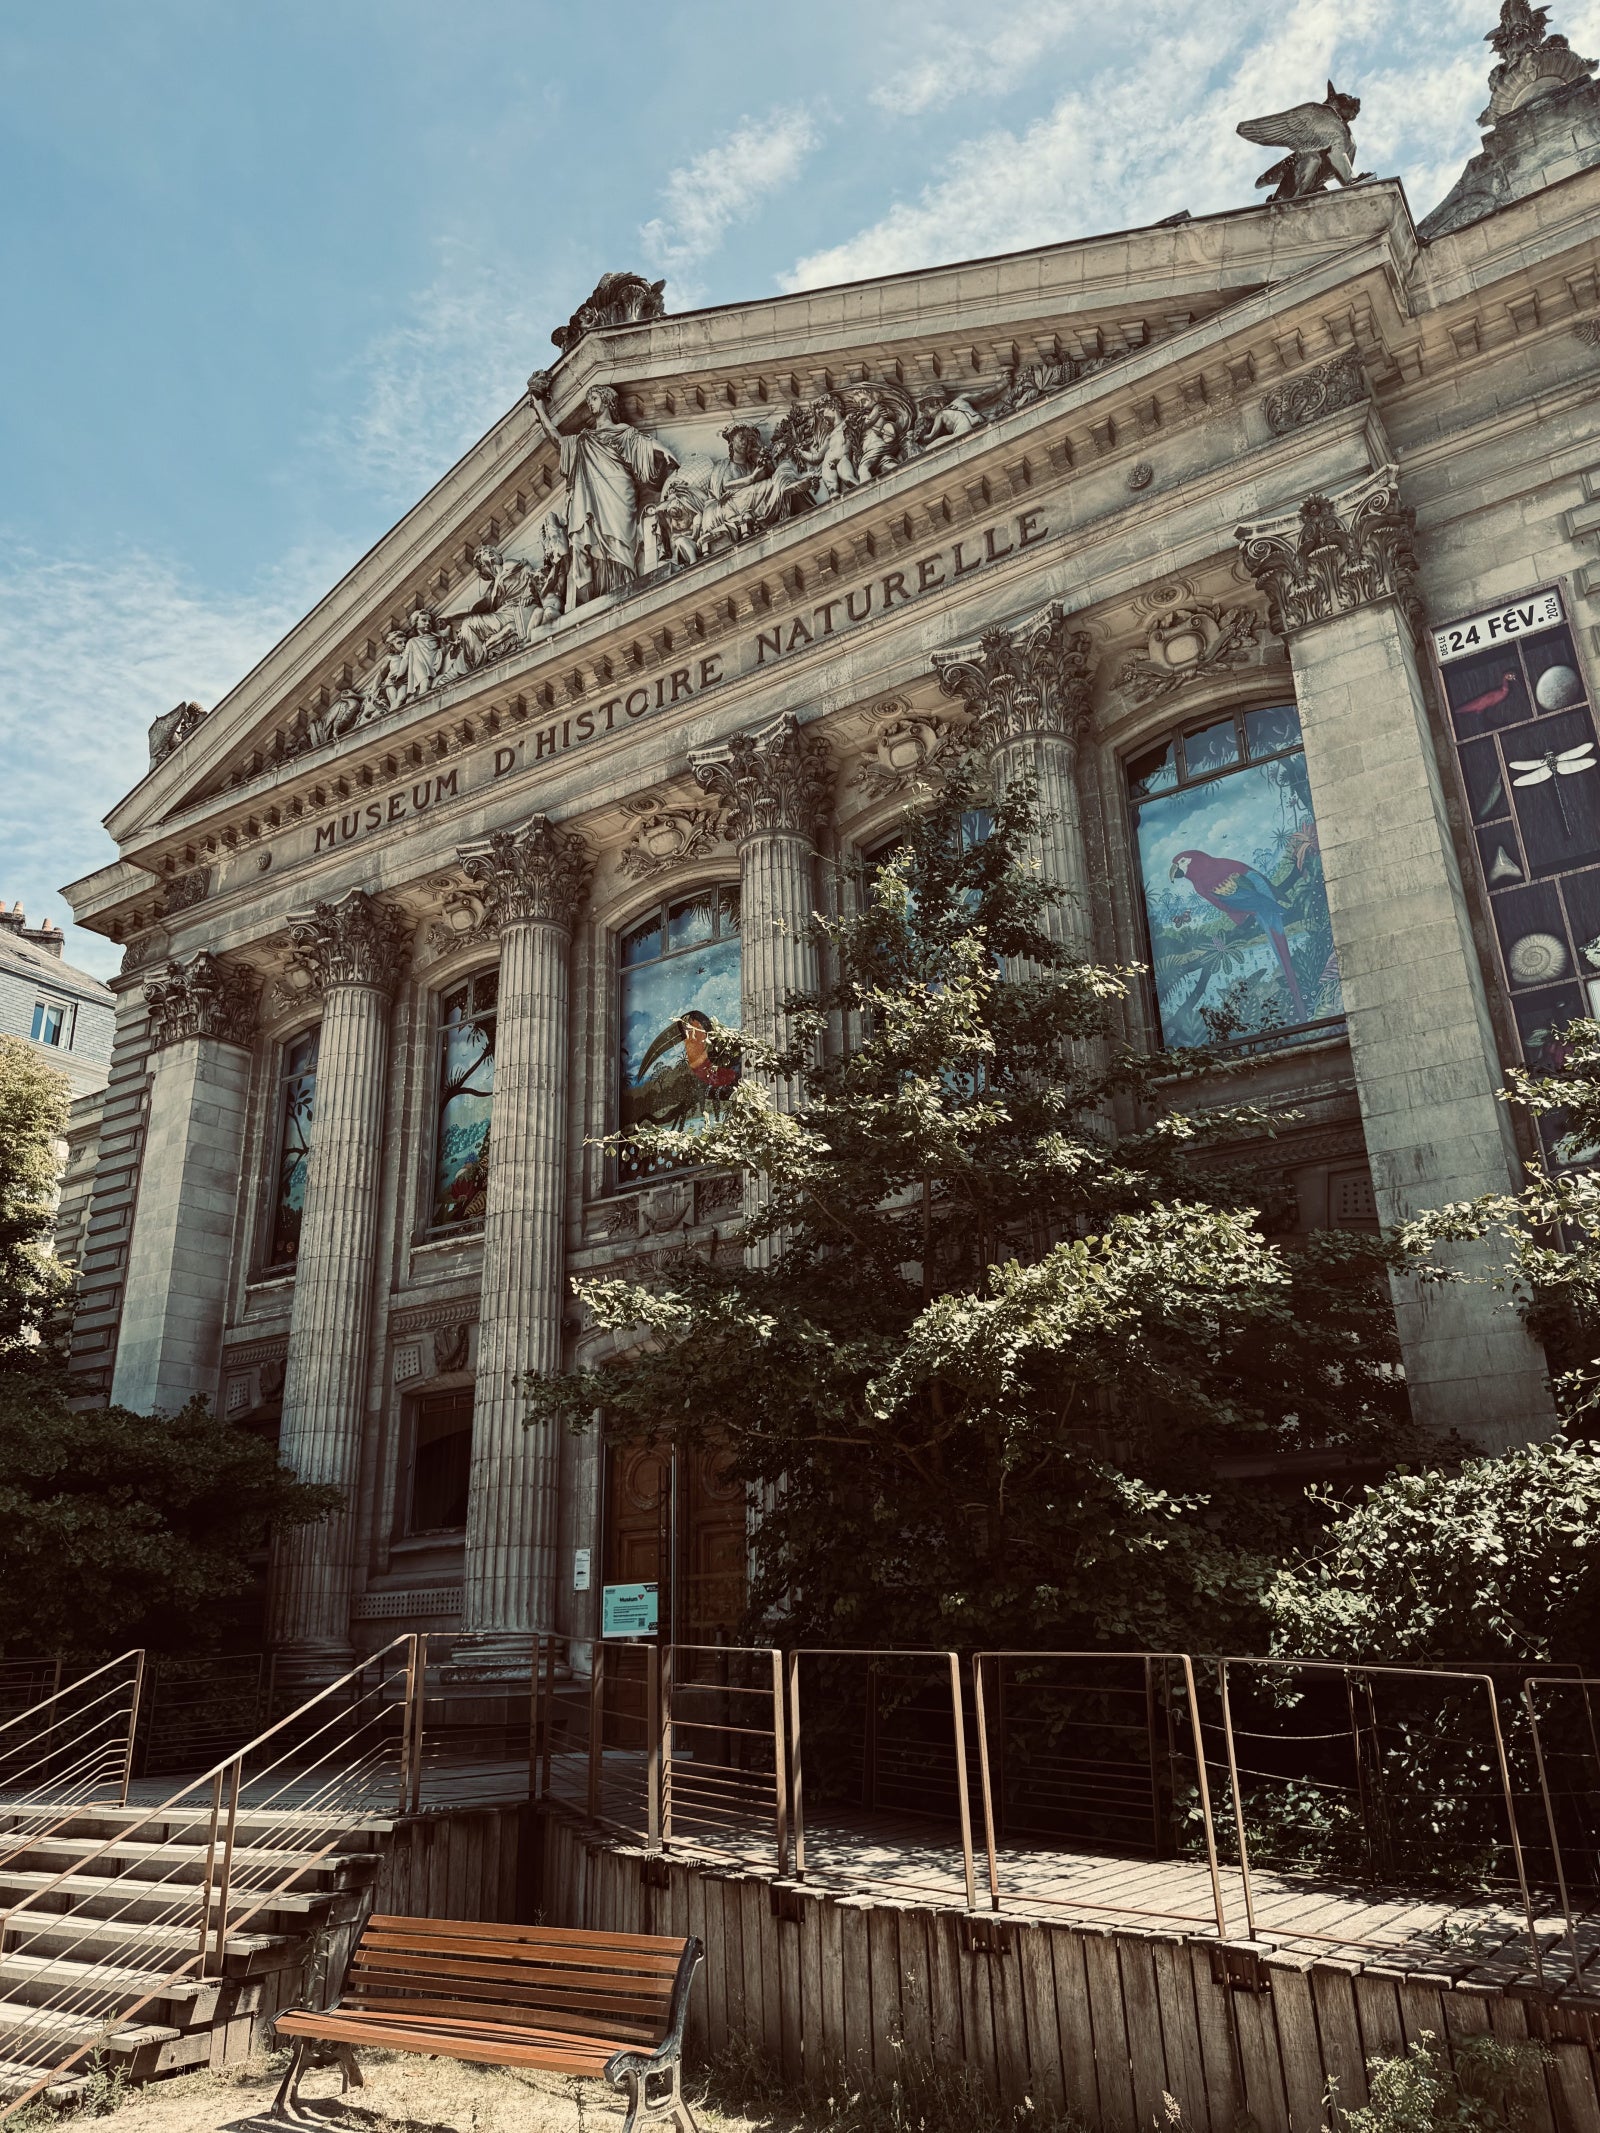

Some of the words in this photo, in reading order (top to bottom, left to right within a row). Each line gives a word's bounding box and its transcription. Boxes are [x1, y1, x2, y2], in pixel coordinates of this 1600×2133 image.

[1448, 625, 1481, 652] 24
[1487, 604, 1545, 639] FÉV.
[1544, 597, 1559, 620] 2024
[314, 768, 458, 853] MUSEUM
[493, 653, 724, 777] D'HISTOIRE
[755, 506, 1049, 664] NATURELLE
